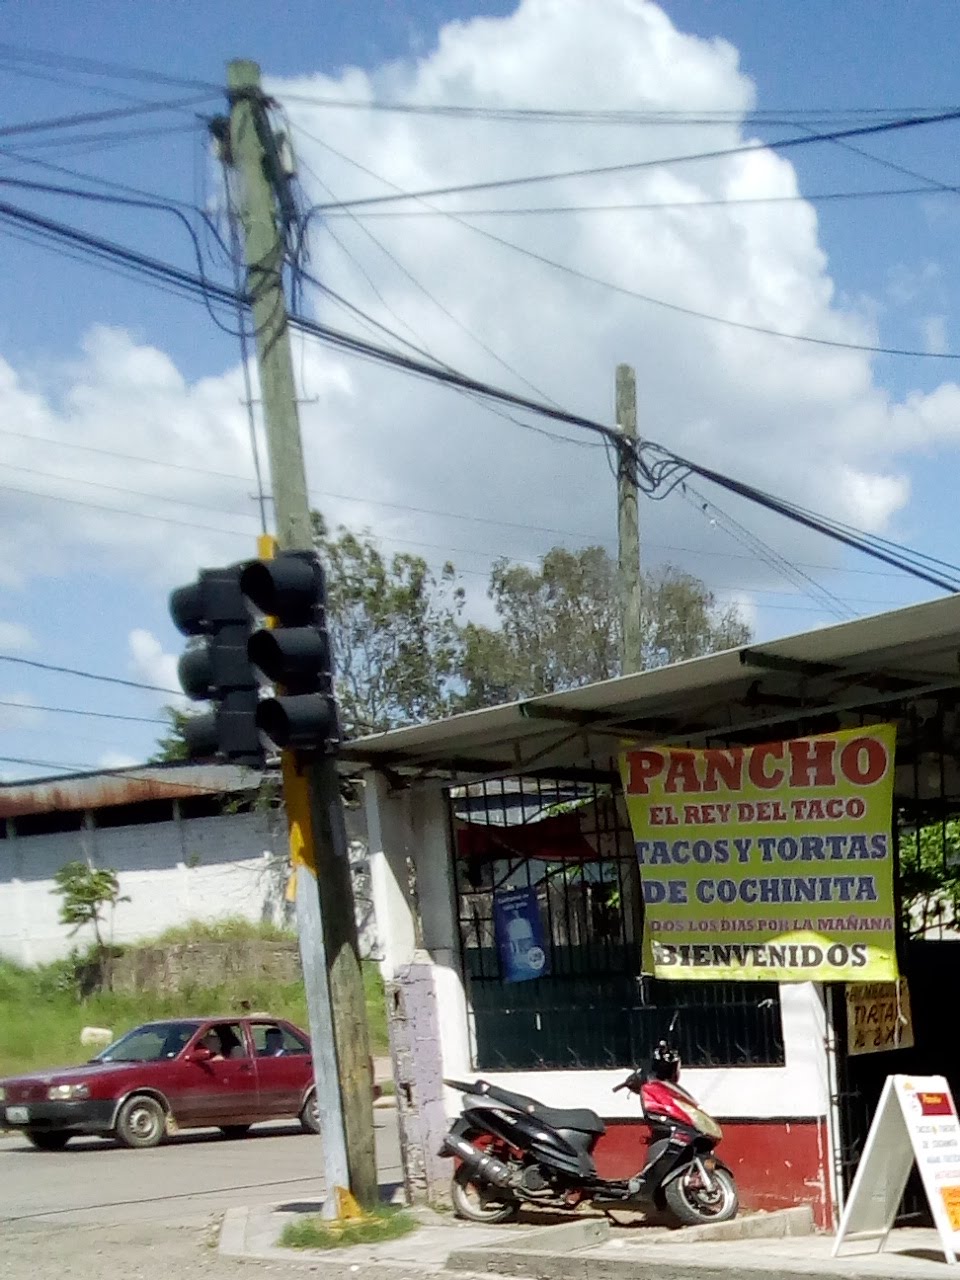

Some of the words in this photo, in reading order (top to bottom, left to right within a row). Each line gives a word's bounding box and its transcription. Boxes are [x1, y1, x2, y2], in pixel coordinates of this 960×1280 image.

[626, 737, 888, 795] PANCHO
[650, 805, 679, 826] EL
[683, 803, 732, 825] REY
[737, 800, 787, 823] DEL
[791, 797, 866, 821] TACO
[635, 839, 731, 865] TACOS
[733, 838, 752, 864] Y
[757, 834, 888, 862] TORTAS
[642, 880, 689, 905] DE
[695, 876, 878, 904] COCHINITA
[688, 919, 719, 933] LOS
[720, 918, 757, 932] DIAS
[757, 918, 790, 931] POR
[792, 919, 815, 931] LA
[816, 914, 894, 931] MAÑANA
[654, 942, 868, 968] BIENVENIDOS
